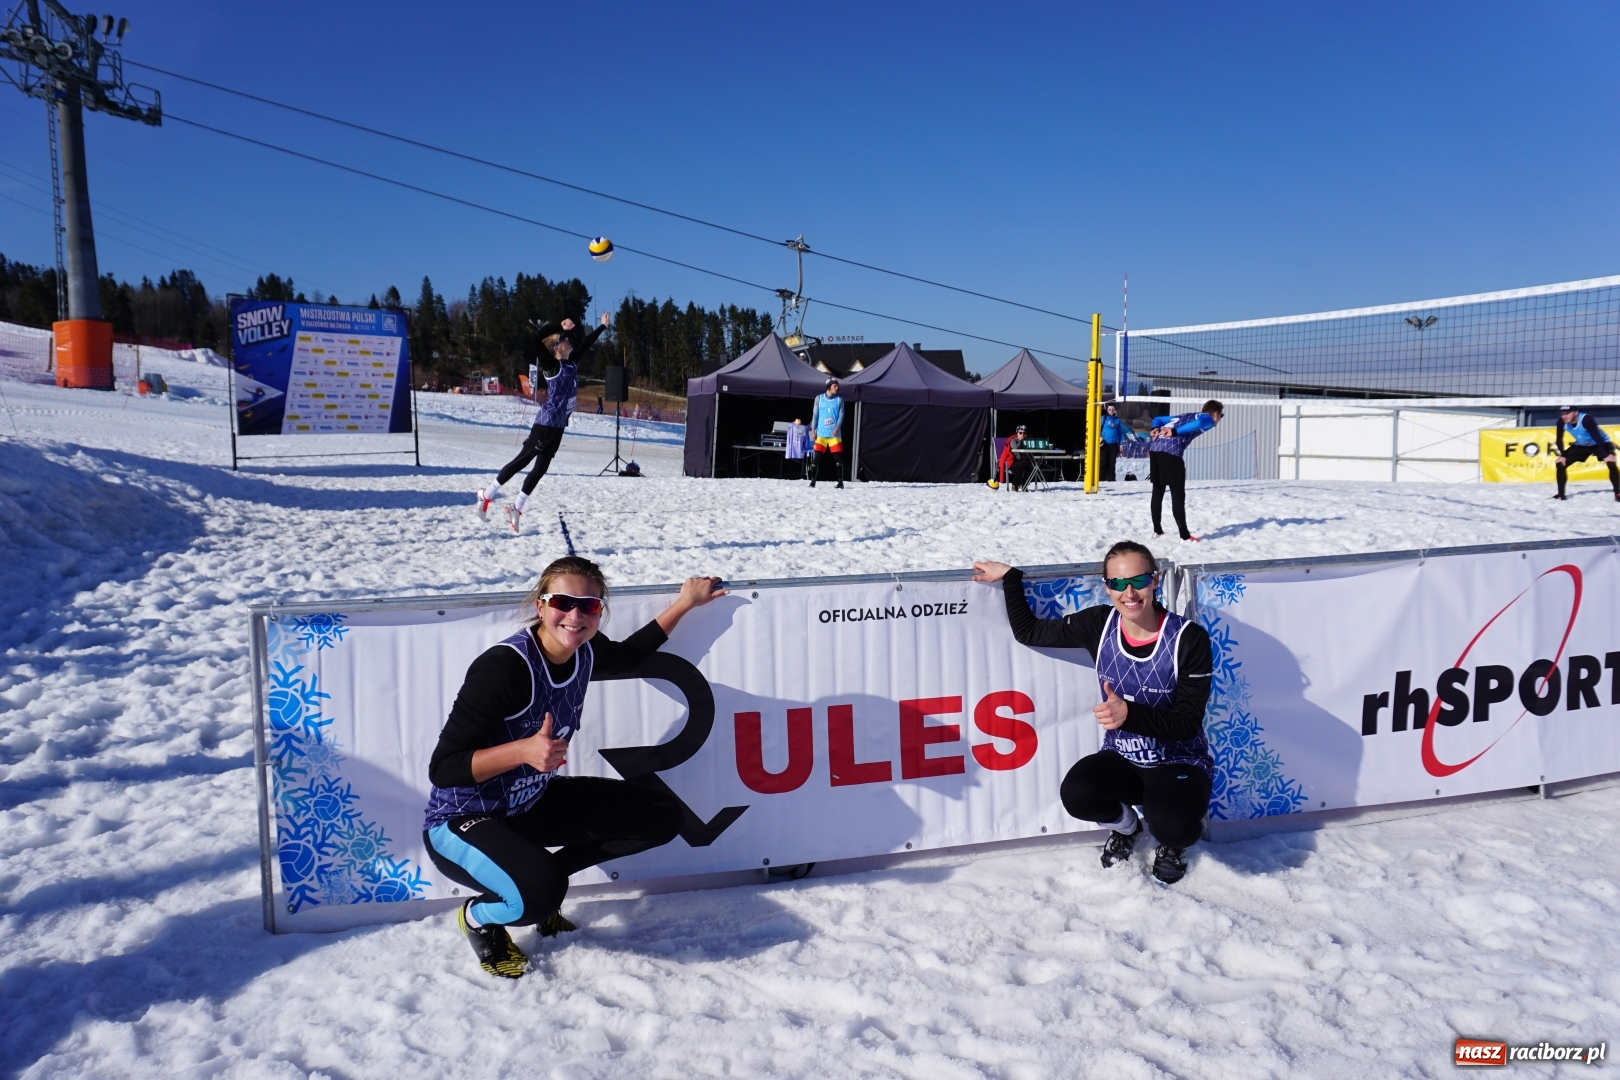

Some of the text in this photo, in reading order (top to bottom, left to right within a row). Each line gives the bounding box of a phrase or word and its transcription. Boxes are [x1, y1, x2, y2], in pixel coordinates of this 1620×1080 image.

[237, 304, 283, 329] SNOW
[300, 307, 351, 322] MISTRZOSTWA
[352, 311, 376, 324] POLSKI
[238, 319, 290, 345] VOLLEY
[818, 599, 968, 623] OFICJALNA ODZIEŻ
[1115, 736, 1157, 753] SNOW
[1119, 747, 1166, 763] OLLEY
